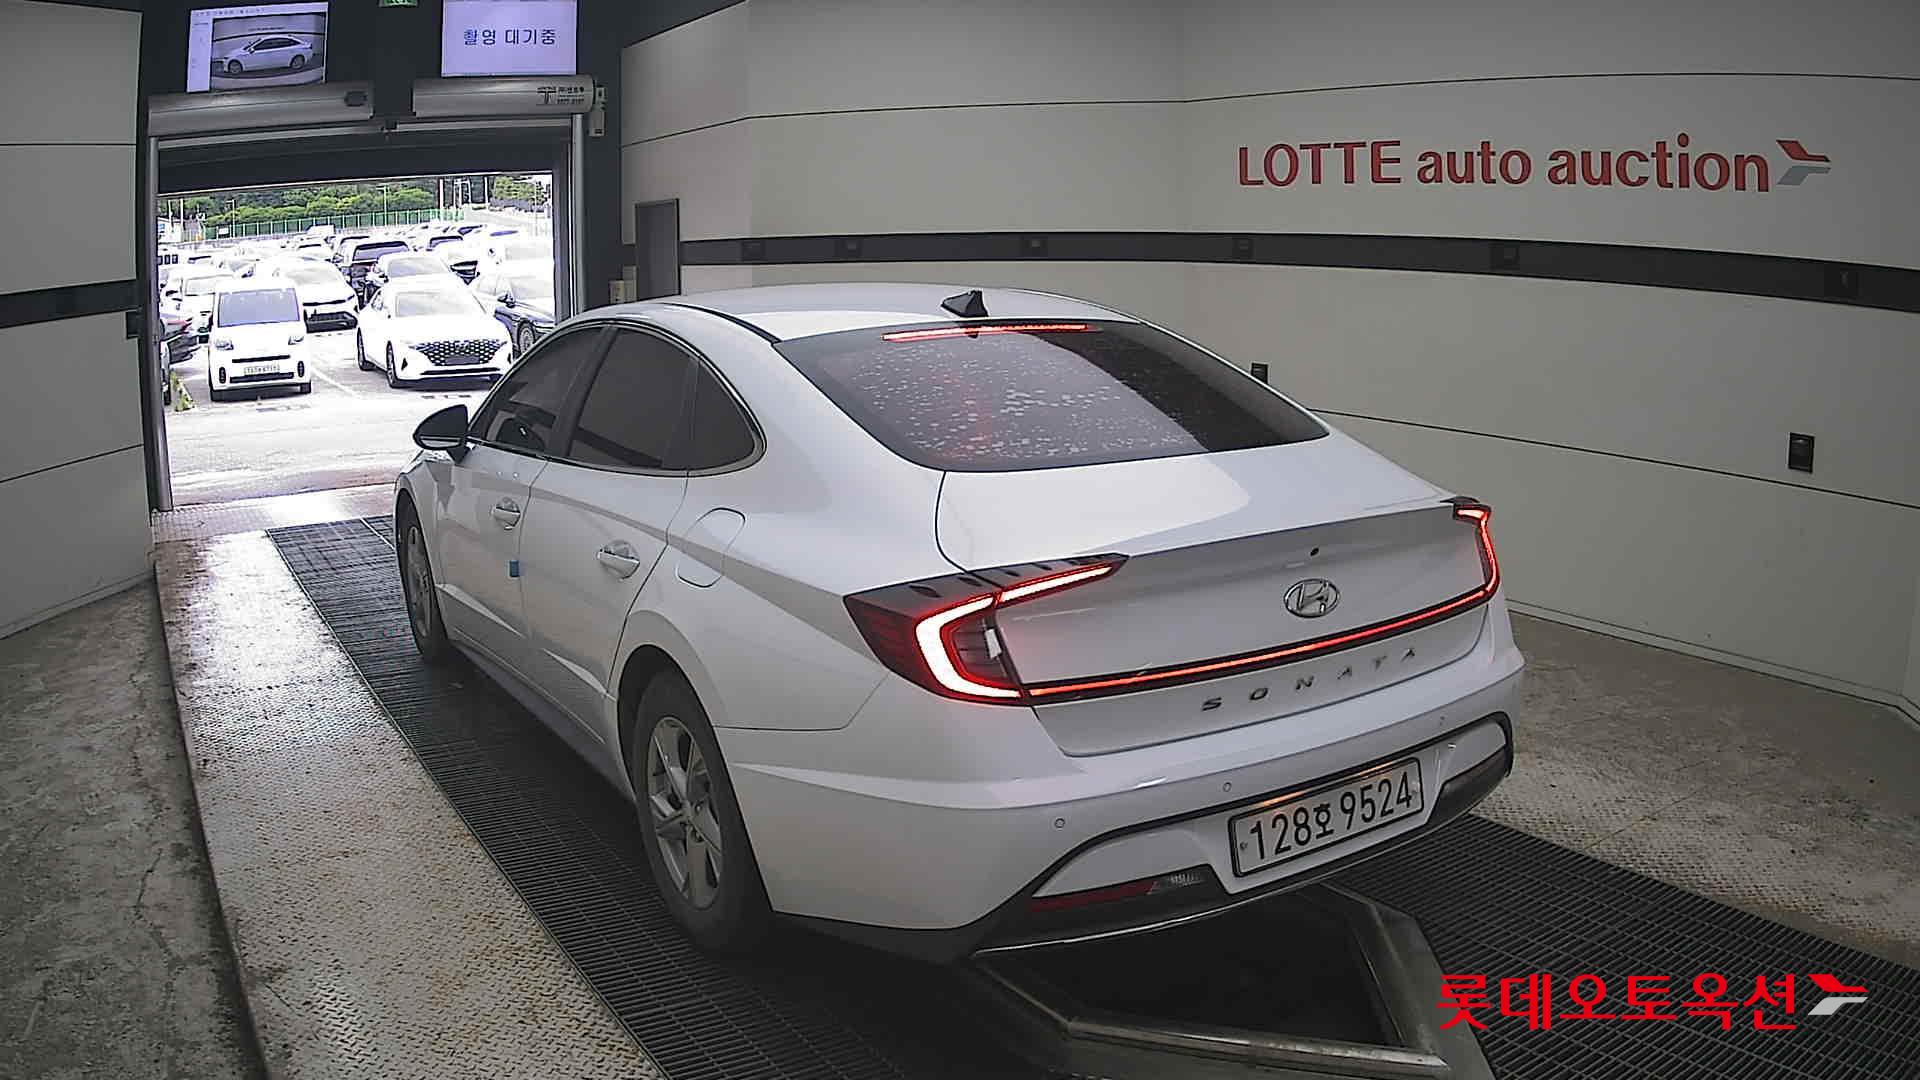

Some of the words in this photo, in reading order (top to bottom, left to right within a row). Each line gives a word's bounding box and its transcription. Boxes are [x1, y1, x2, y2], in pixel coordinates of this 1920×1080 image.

[505, 29, 556, 45] 대기중
[1239, 139, 1402, 186] LOTTE
[1417, 140, 1532, 185] auto
[1547, 132, 1770, 192] auction
[1202, 648, 1416, 711] SONATA
[1340, 771, 1413, 830] 9524
